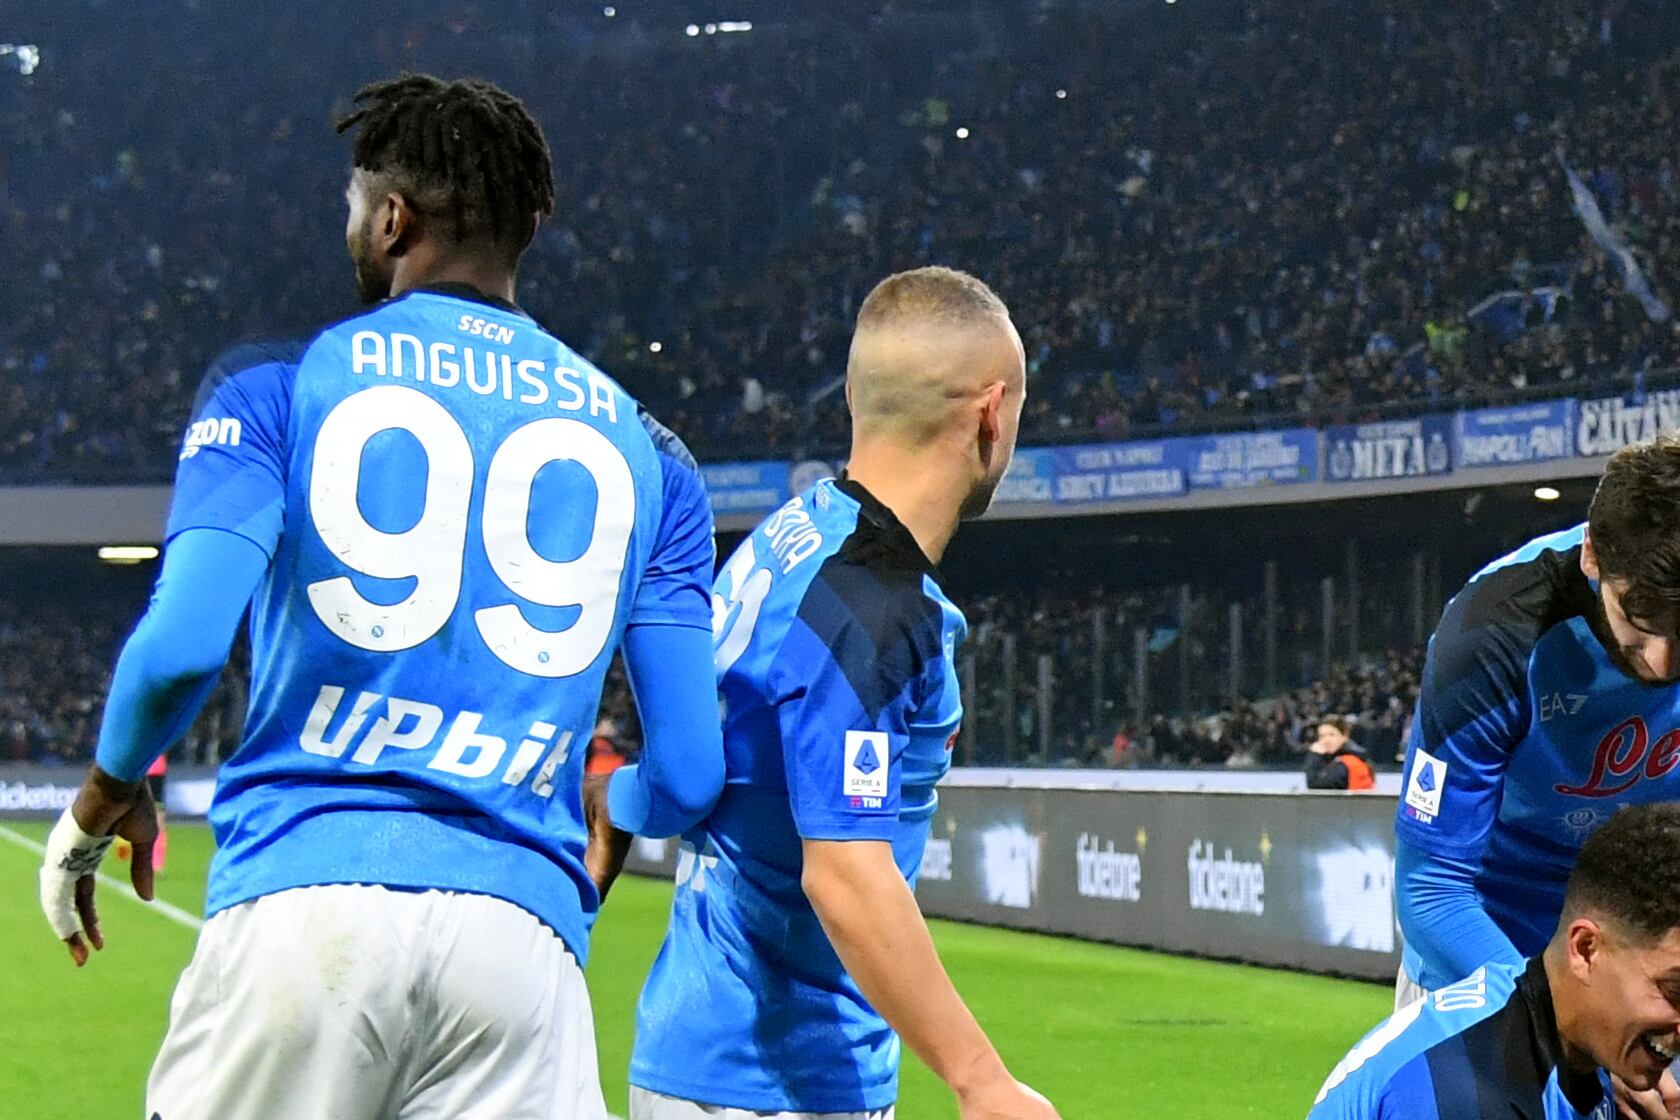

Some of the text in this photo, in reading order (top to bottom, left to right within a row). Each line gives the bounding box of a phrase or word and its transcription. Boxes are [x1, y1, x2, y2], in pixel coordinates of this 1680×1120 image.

[457, 314, 515, 345] SSCN
[351, 330, 620, 425] ANGUISSA
[184, 416, 242, 448] zon
[306, 384, 637, 680] 99
[1539, 692, 1590, 722] EA7
[862, 796, 882, 809] TIM
[1414, 809, 1432, 825] TIM
